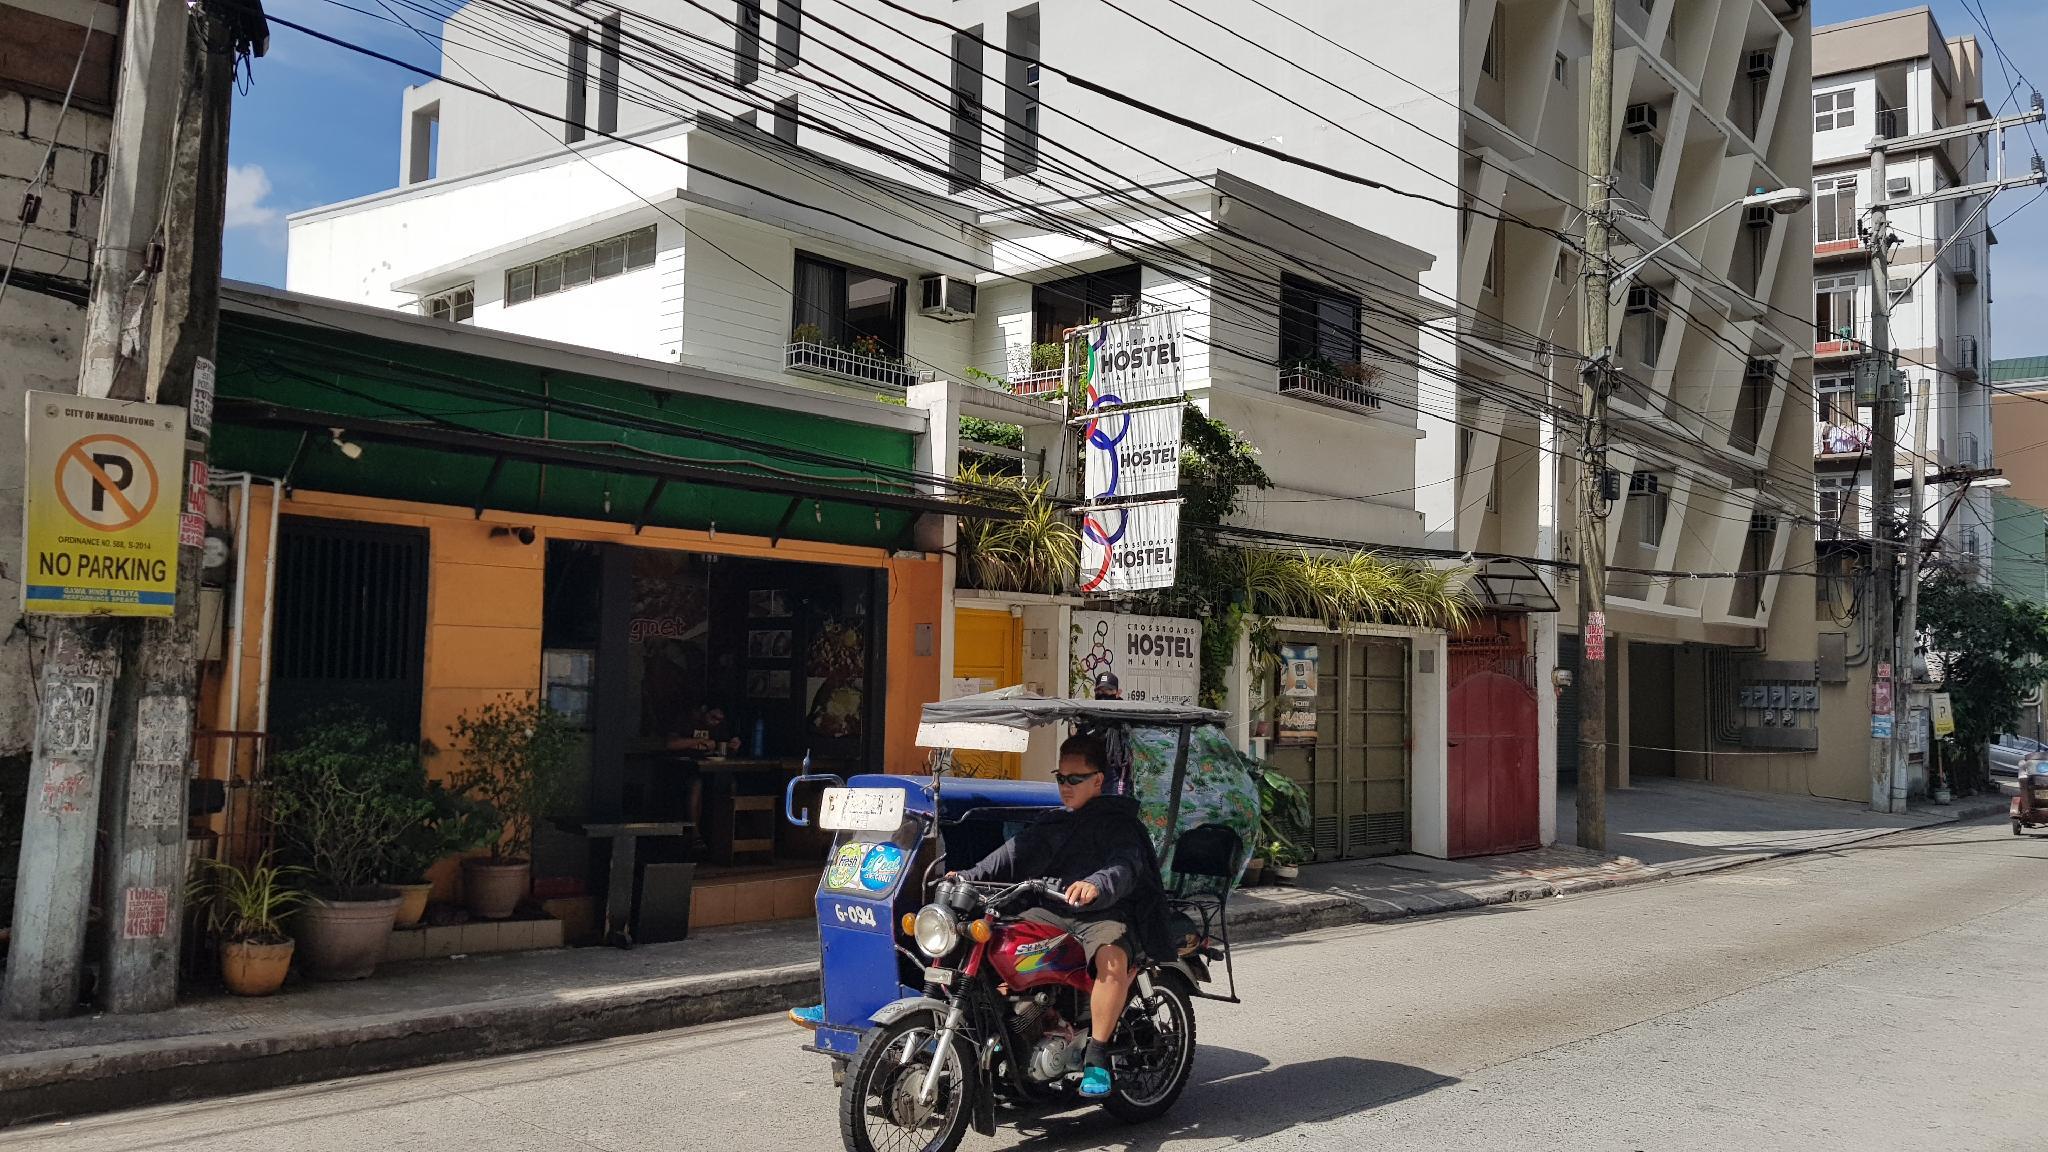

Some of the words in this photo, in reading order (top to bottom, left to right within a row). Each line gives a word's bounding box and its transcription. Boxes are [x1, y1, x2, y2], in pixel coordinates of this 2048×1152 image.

[1101, 342, 1181, 374] HOSTEL
[65, 408, 83, 419] CITY
[85, 410, 94, 420] OF
[1120, 447, 1177, 468] HOSTEL
[92, 453, 133, 512] P
[58, 536, 100, 546] ORDINANCE
[40, 552, 71, 576] NO
[77, 554, 167, 582] PARKING
[1112, 547, 1172, 568] HOSTEL
[1128, 623, 1194, 635] CROSSROADS
[1127, 633, 1194, 659] HOSTEL
[835, 903, 877, 928] G-094
